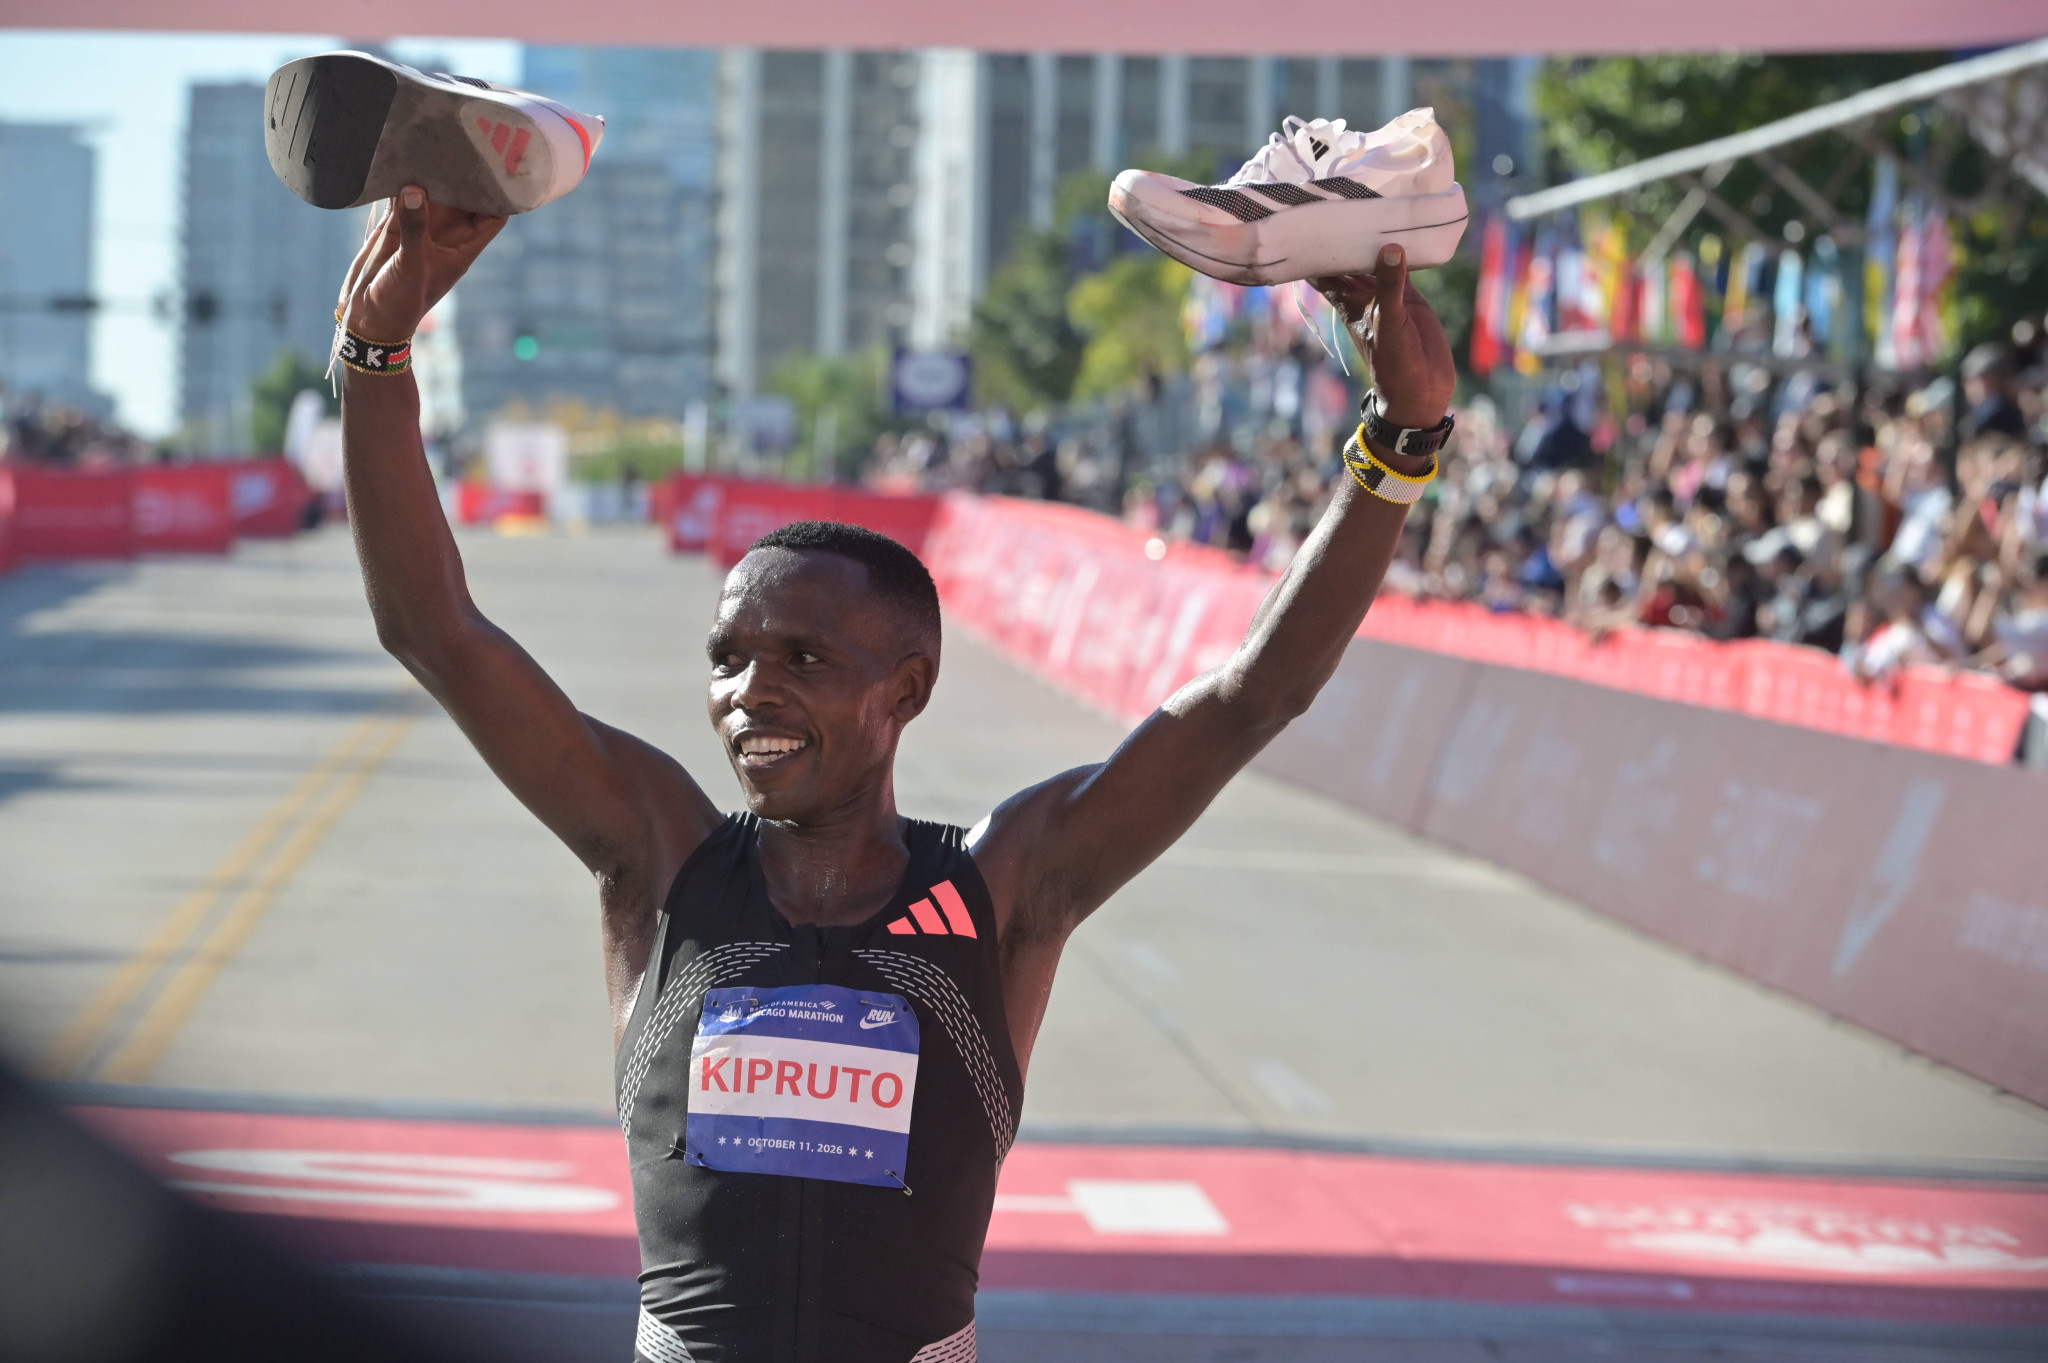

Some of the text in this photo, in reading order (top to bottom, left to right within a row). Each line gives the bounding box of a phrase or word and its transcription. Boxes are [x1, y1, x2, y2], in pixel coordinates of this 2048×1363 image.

[781, 1000, 818, 1009] AMERICA
[788, 1009, 844, 1024] MARATHON
[866, 1009, 896, 1022] RUN
[701, 1056, 904, 1109] KIPRUTO
[747, 1137, 843, 1155] OCTOBER 11, 2026
